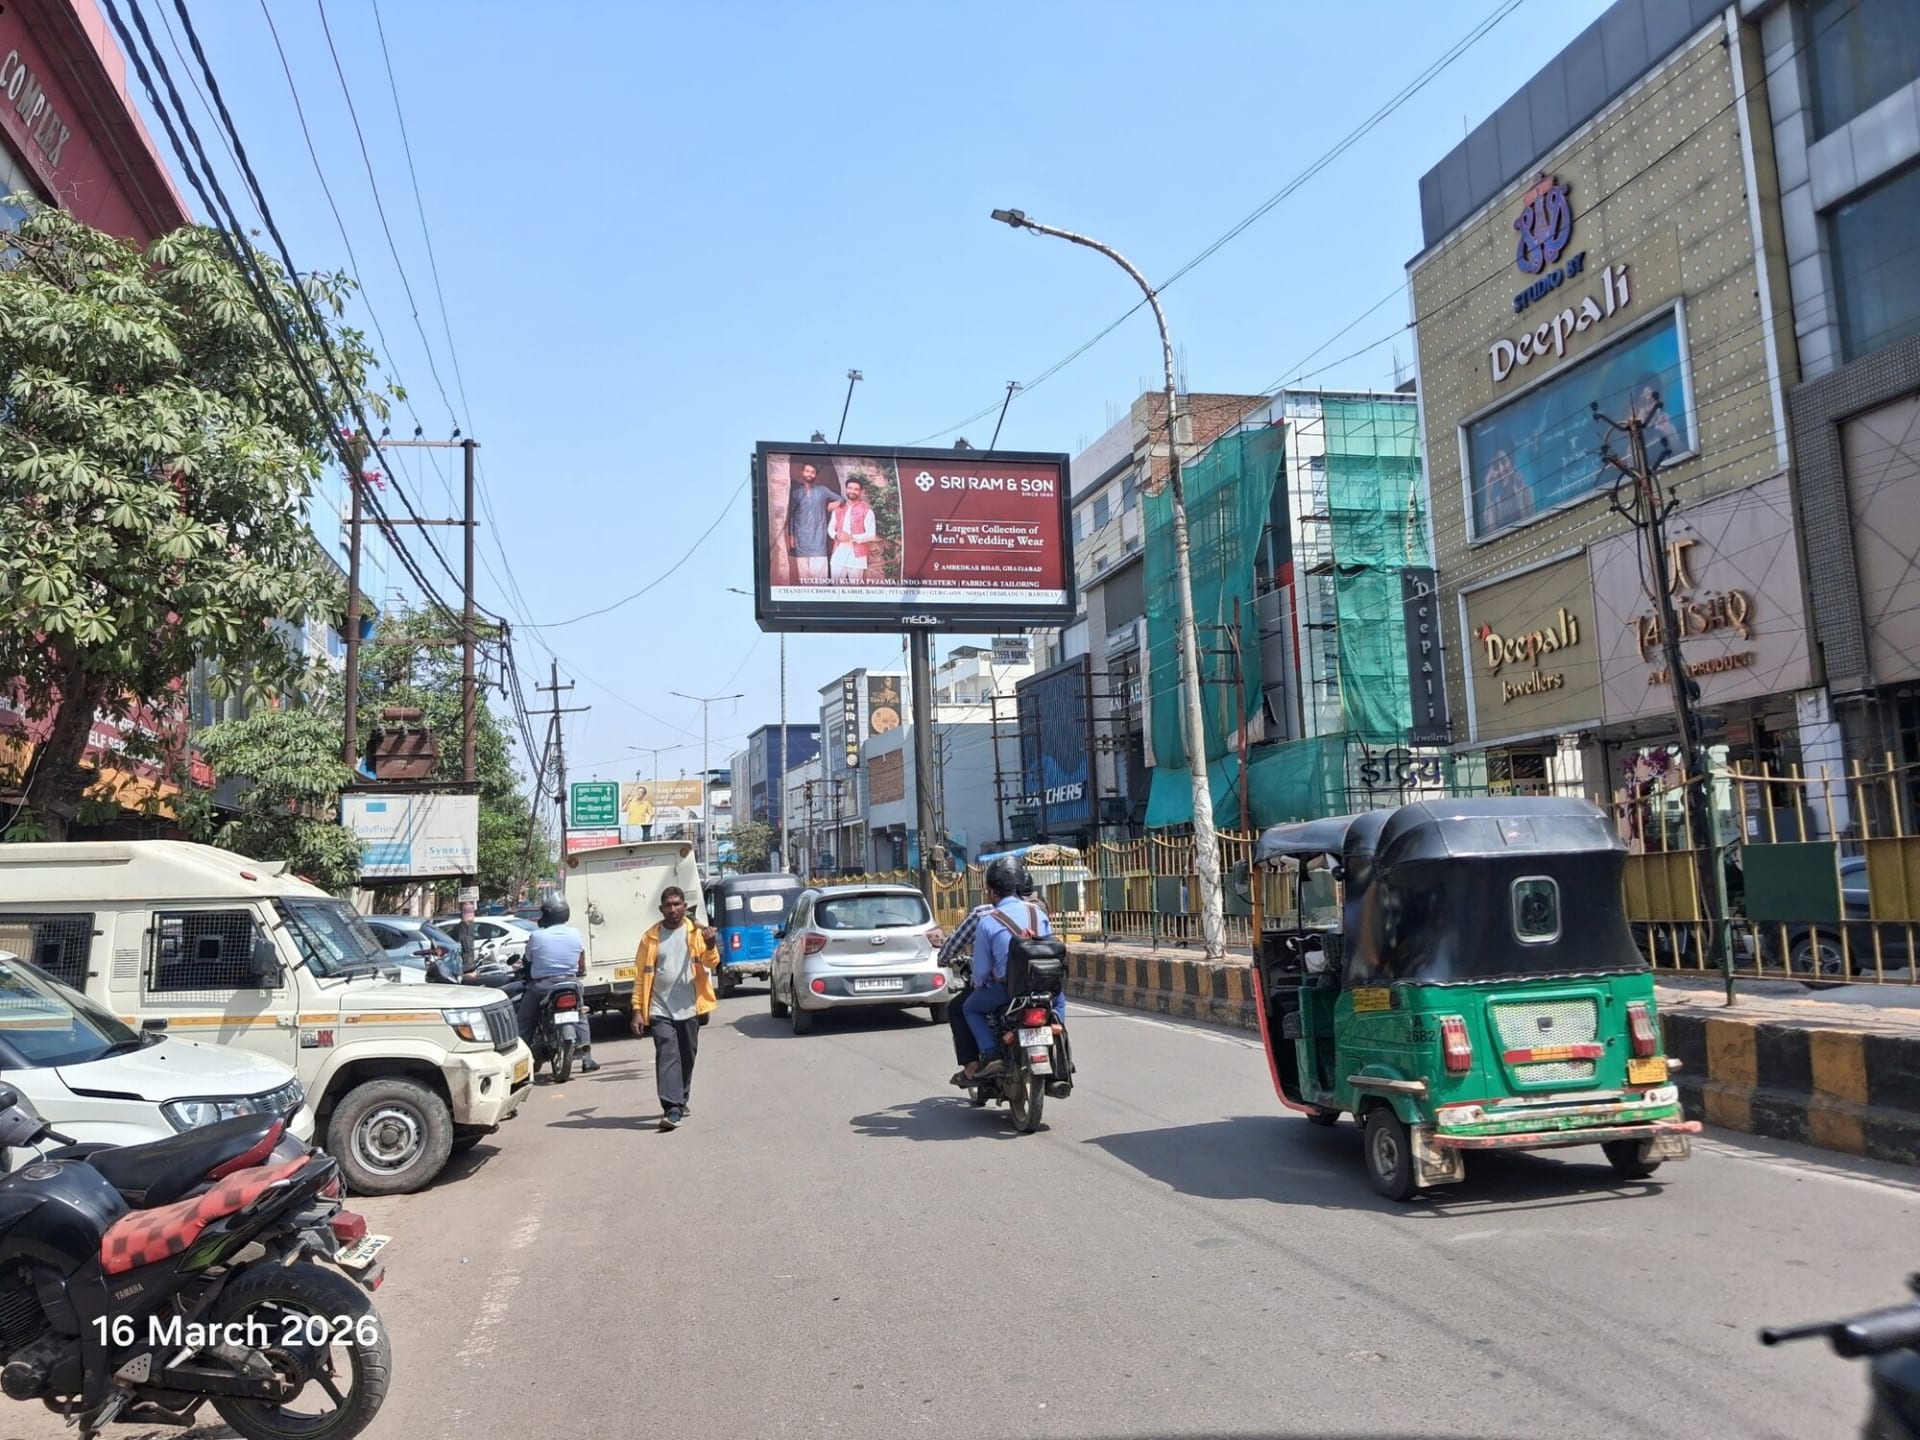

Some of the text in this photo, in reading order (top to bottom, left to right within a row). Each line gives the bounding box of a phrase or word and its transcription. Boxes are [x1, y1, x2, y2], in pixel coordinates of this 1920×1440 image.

[0, 50, 71, 168] COMPLEX
[1513, 251, 1587, 314] STUDIO BY
[1488, 263, 1631, 383] Deepali
[940, 476, 1054, 492] SRI RAM & SON
[931, 534, 1044, 548] Men's Wedding Wear
[946, 524, 980, 534] Largest
[981, 525, 1025, 535] Collection
[1029, 526, 1039, 534] of
[799, 577, 834, 585] TUXEDOS
[866, 578, 897, 586] PYJAMA
[900, 579, 957, 587] INDO-WESTERN
[1416, 580, 1435, 721] Deepali
[1485, 607, 1579, 670] Deepali
[1627, 588, 1752, 665] TAISHQ
[1502, 671, 1564, 706] Jewellers
[114, 1282, 145, 1301] YAMAHA
